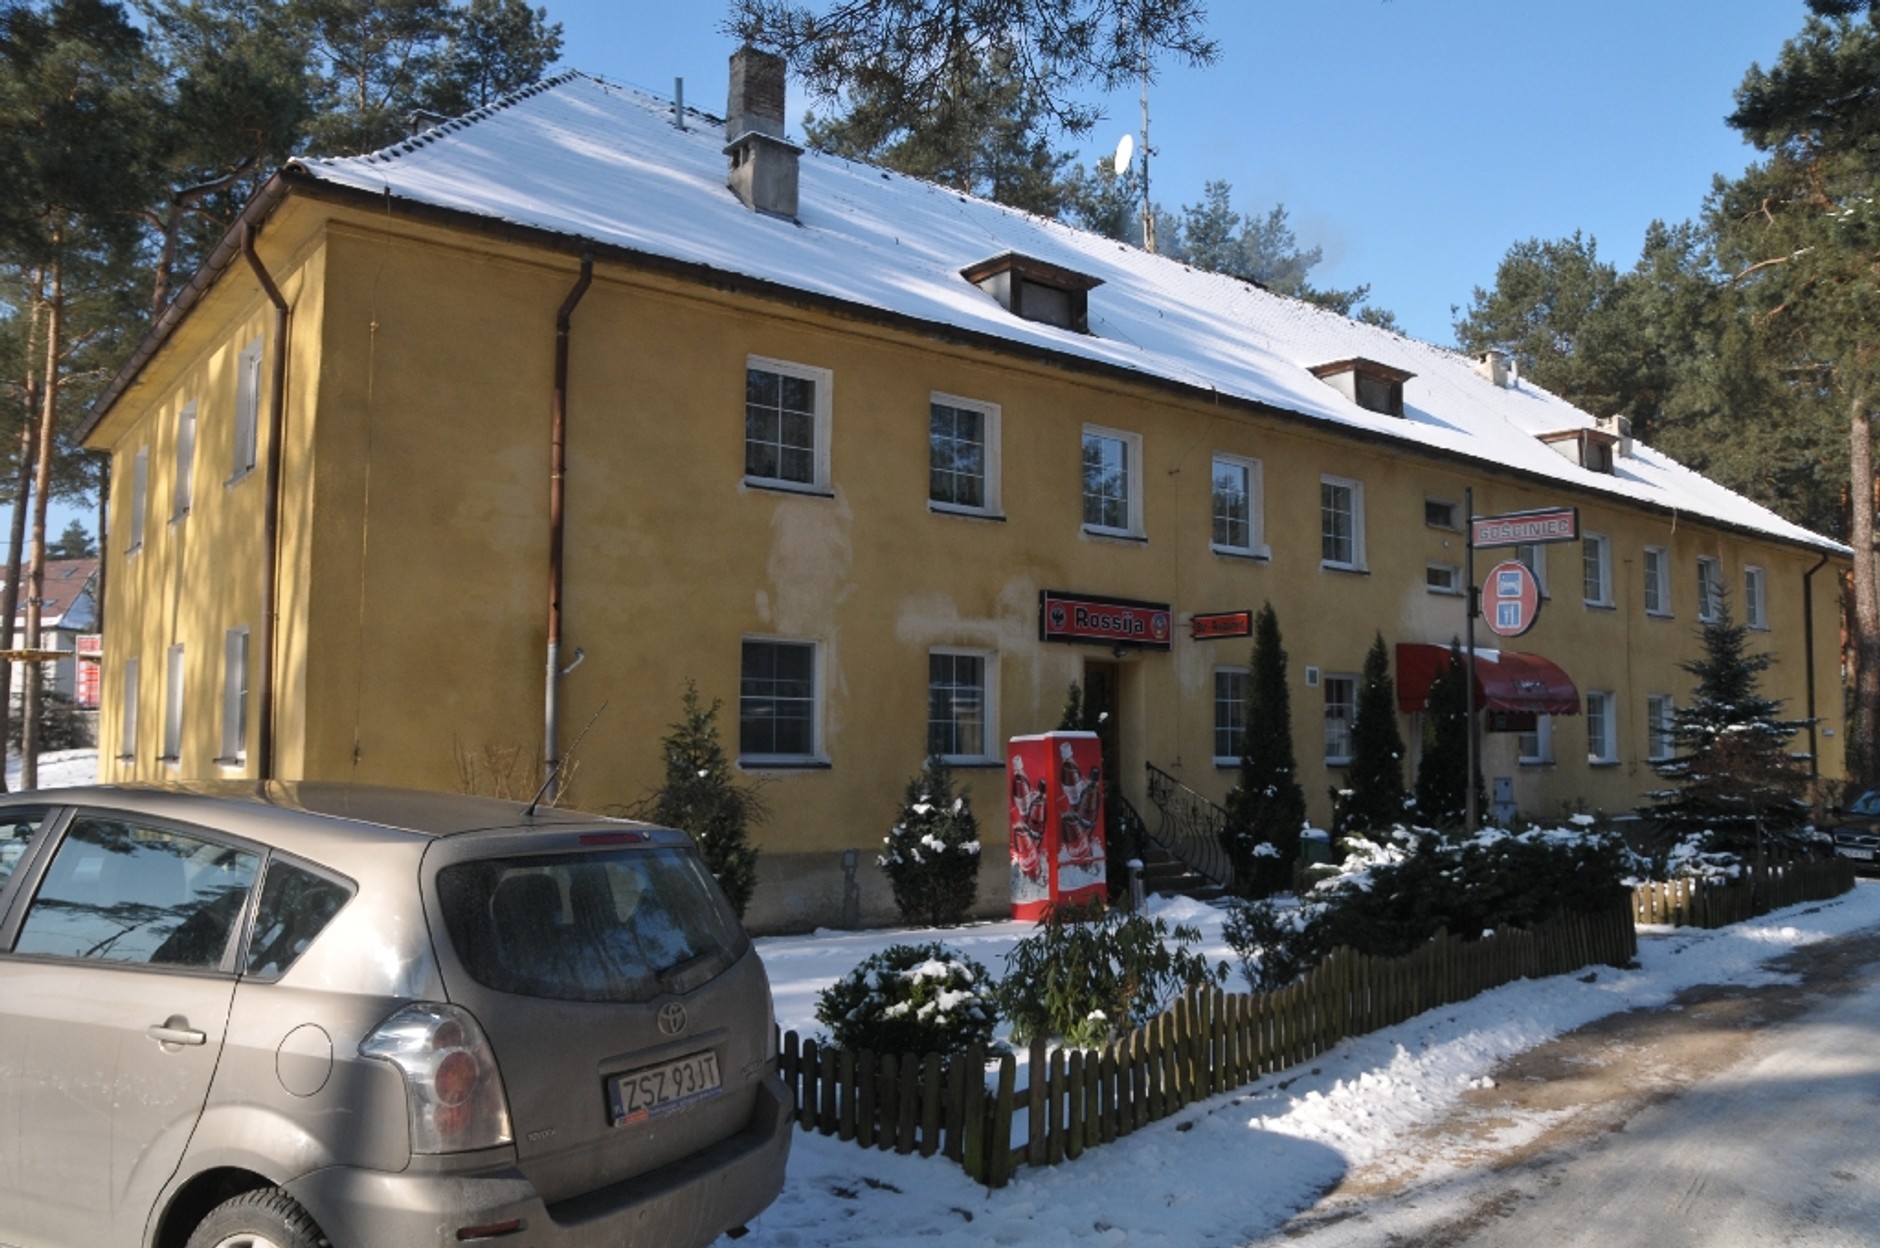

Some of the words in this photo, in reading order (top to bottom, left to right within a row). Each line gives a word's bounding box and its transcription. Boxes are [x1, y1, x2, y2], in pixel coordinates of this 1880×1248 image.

[1075, 606, 1144, 635] Rossija
[623, 1071, 670, 1111] ZSZ
[672, 1055, 716, 1096] 93JT
